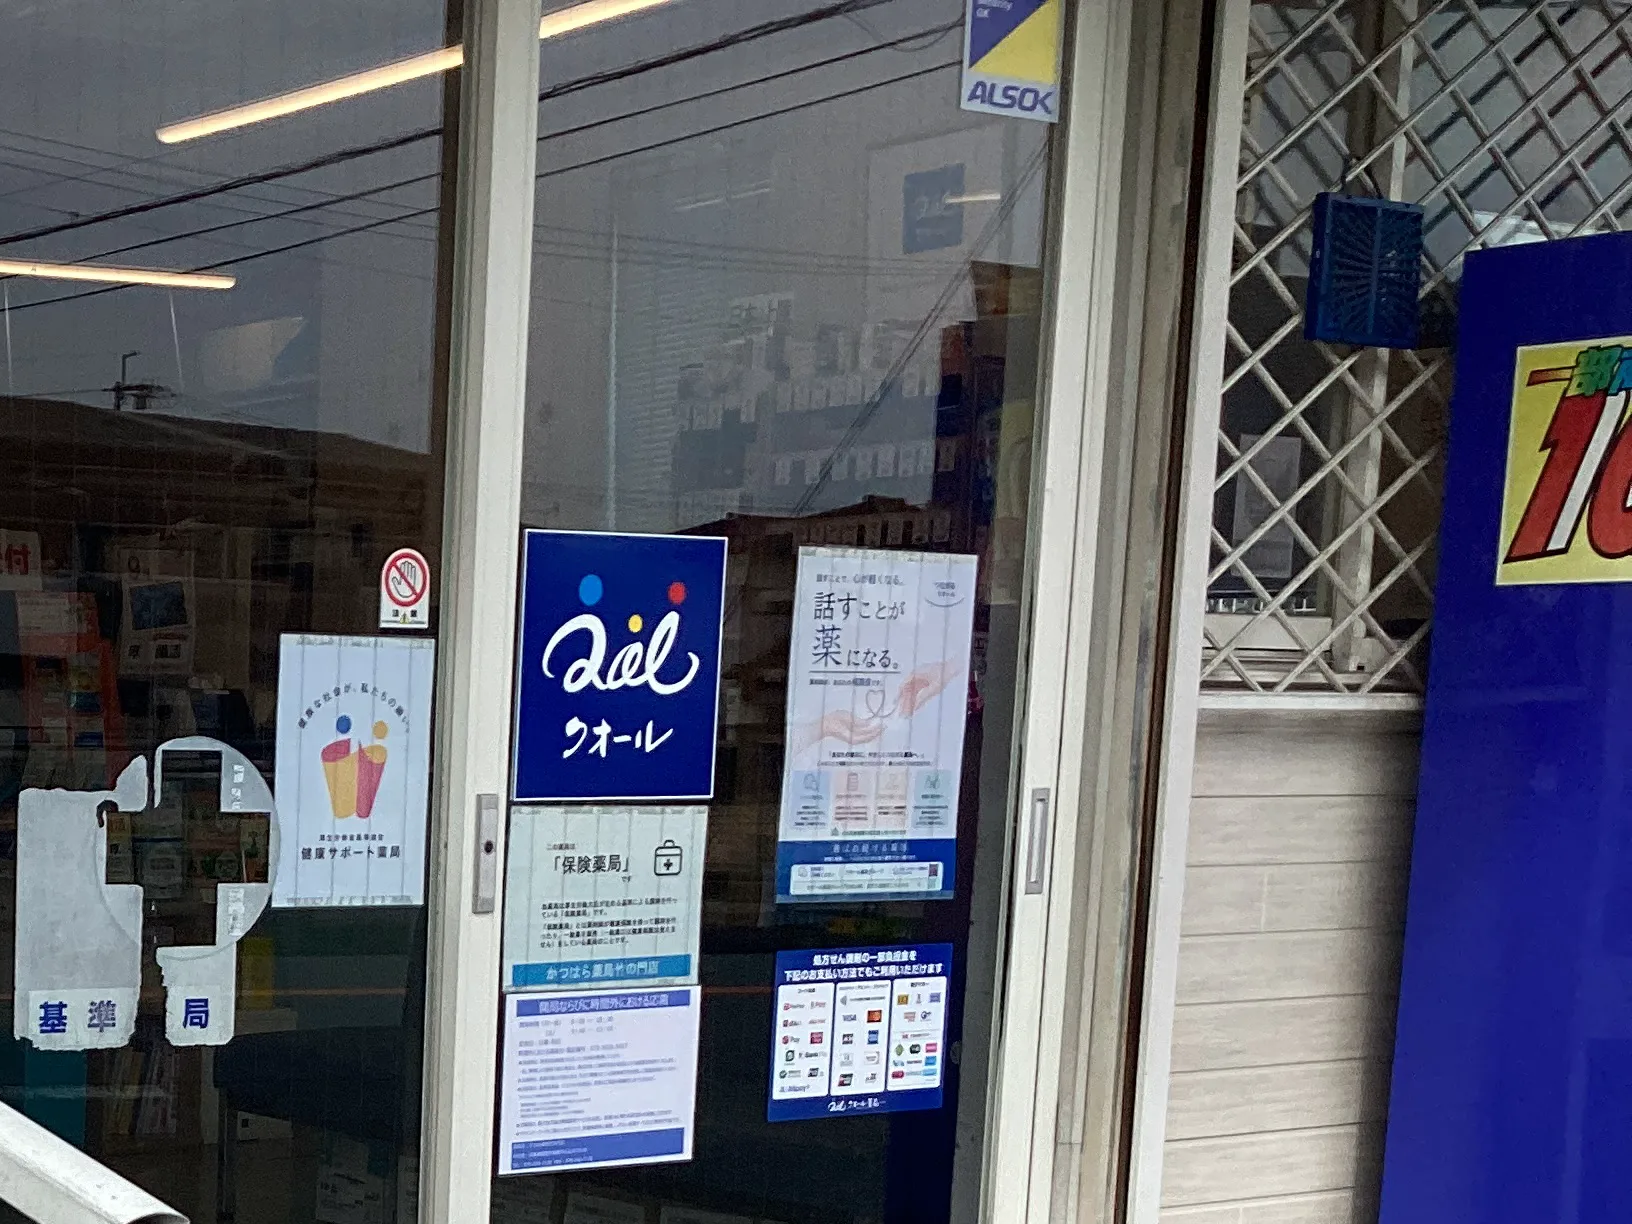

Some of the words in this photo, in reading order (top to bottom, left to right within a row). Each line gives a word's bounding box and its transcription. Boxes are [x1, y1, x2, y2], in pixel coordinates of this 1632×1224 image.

[967, 80, 1054, 115] ALSOK
[813, 591, 905, 621] 話すことが
[812, 624, 899, 669] 薬になる。
[562, 715, 674, 759] クオール
[301, 844, 401, 861] 健康サポート薬局
[553, 854, 630, 875] 「保険薬局」
[621, 875, 632, 883] です
